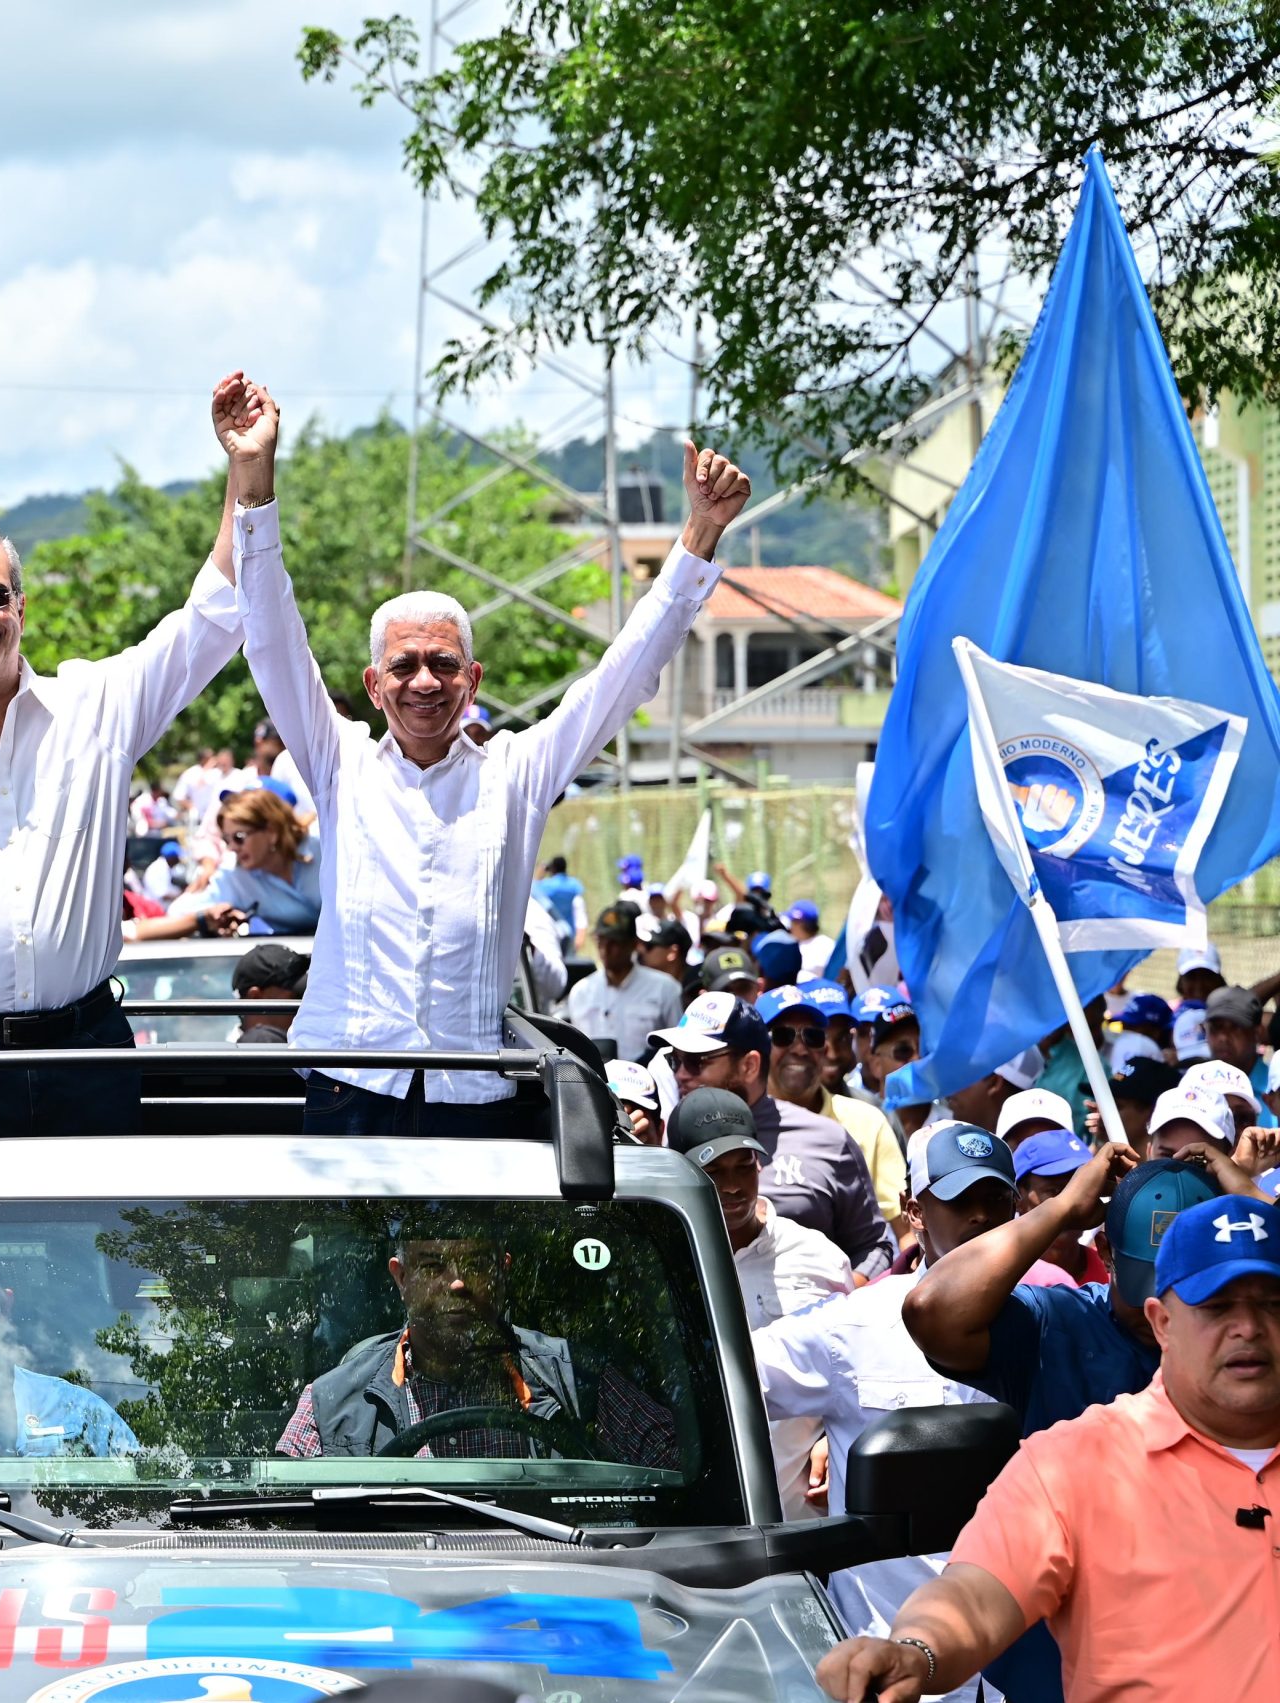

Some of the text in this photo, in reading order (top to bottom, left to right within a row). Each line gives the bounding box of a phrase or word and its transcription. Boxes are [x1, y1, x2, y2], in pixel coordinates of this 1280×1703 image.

[1019, 738, 1086, 770] MODERNO
[1080, 803, 1100, 832] PRM
[579, 1245, 602, 1264] 17
[550, 1495, 657, 1504] BRONCO
[65, 1661, 340, 1691] REVOLUCIONARIO
